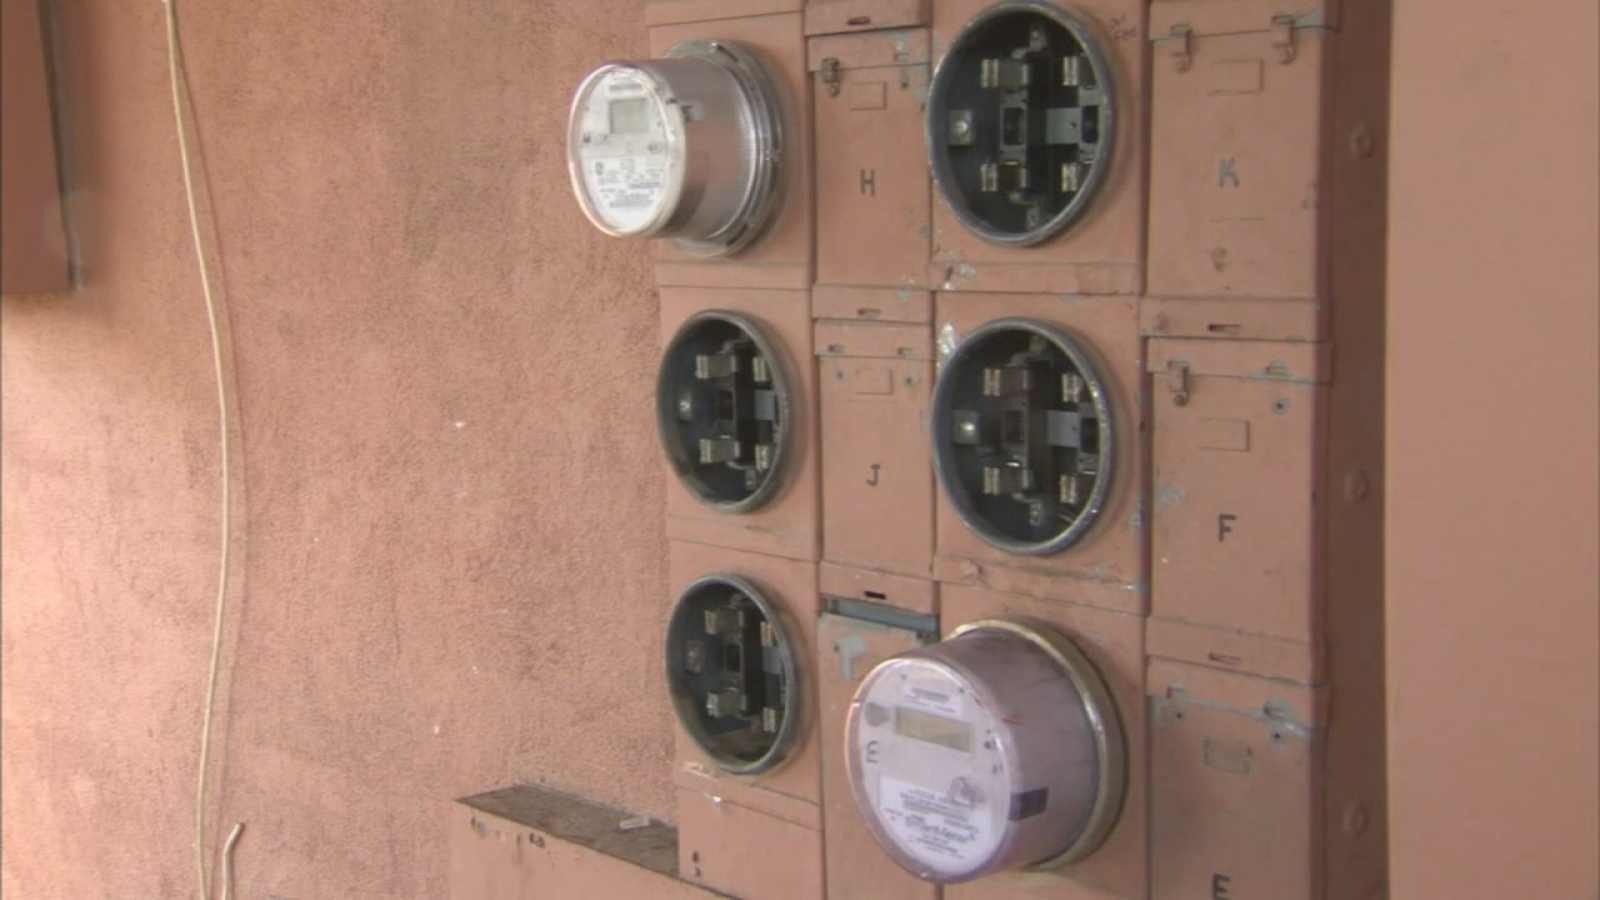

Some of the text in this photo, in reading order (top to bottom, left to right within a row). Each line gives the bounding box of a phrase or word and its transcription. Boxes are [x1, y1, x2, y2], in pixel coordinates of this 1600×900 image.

[860, 169, 876, 197] H
[1219, 157, 1240, 188] K
[866, 464, 881, 487] J
[1219, 514, 1237, 543] F
[1213, 873, 1231, 900] E
